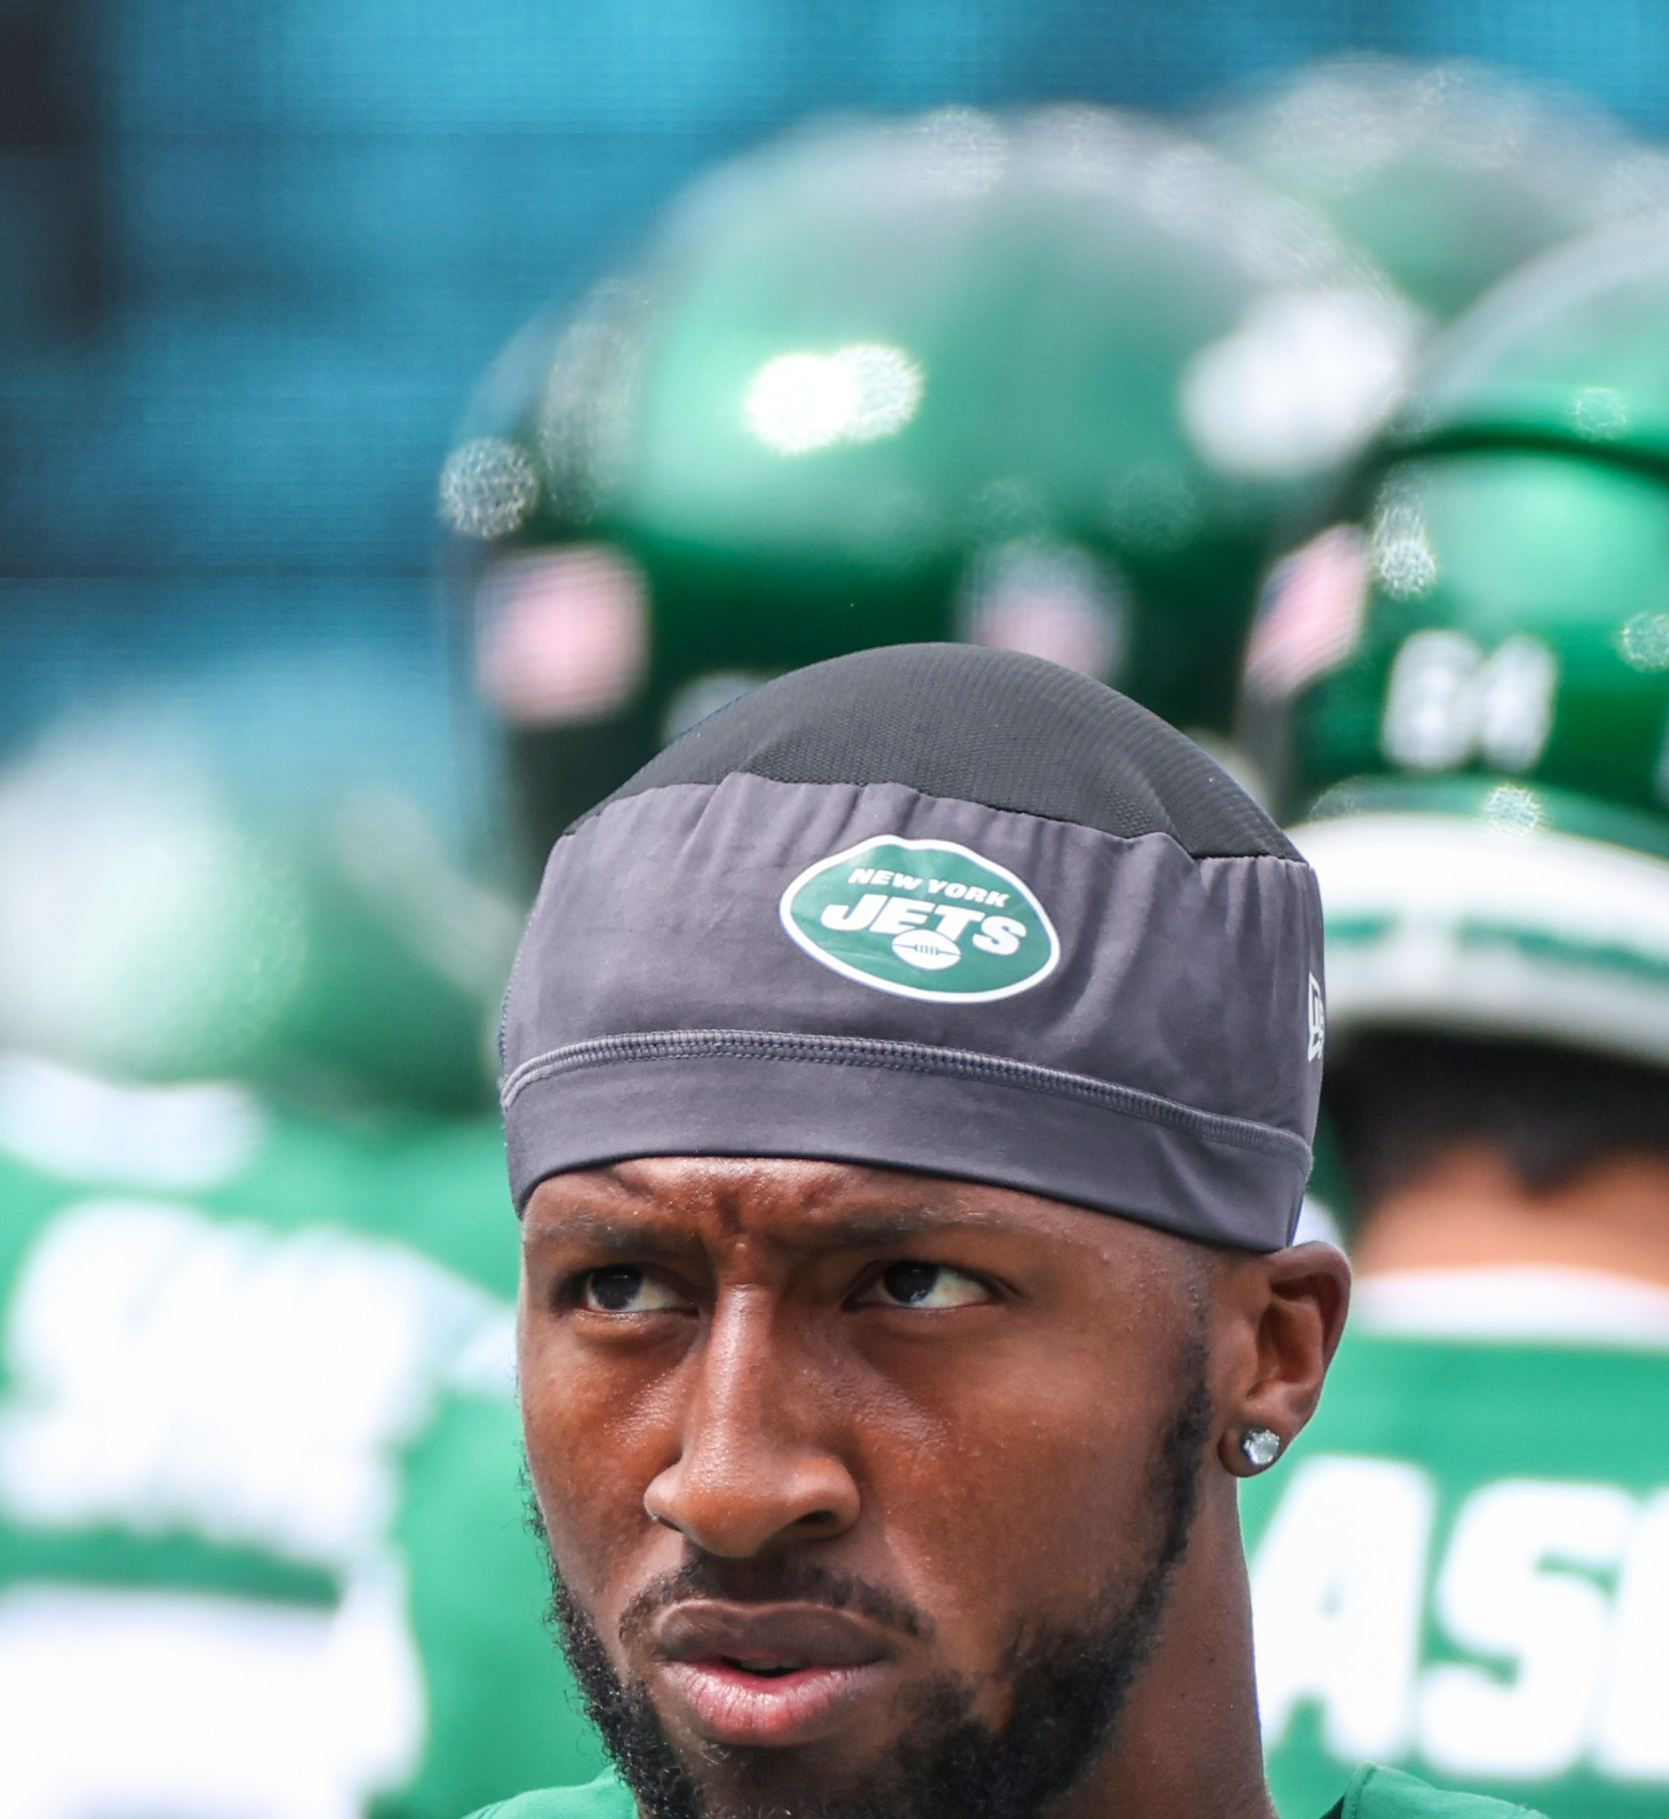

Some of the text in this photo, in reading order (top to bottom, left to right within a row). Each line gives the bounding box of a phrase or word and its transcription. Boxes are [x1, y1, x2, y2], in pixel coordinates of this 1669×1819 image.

[847, 867, 1011, 909] NEW YORK
[819, 893, 1028, 957] JETS
